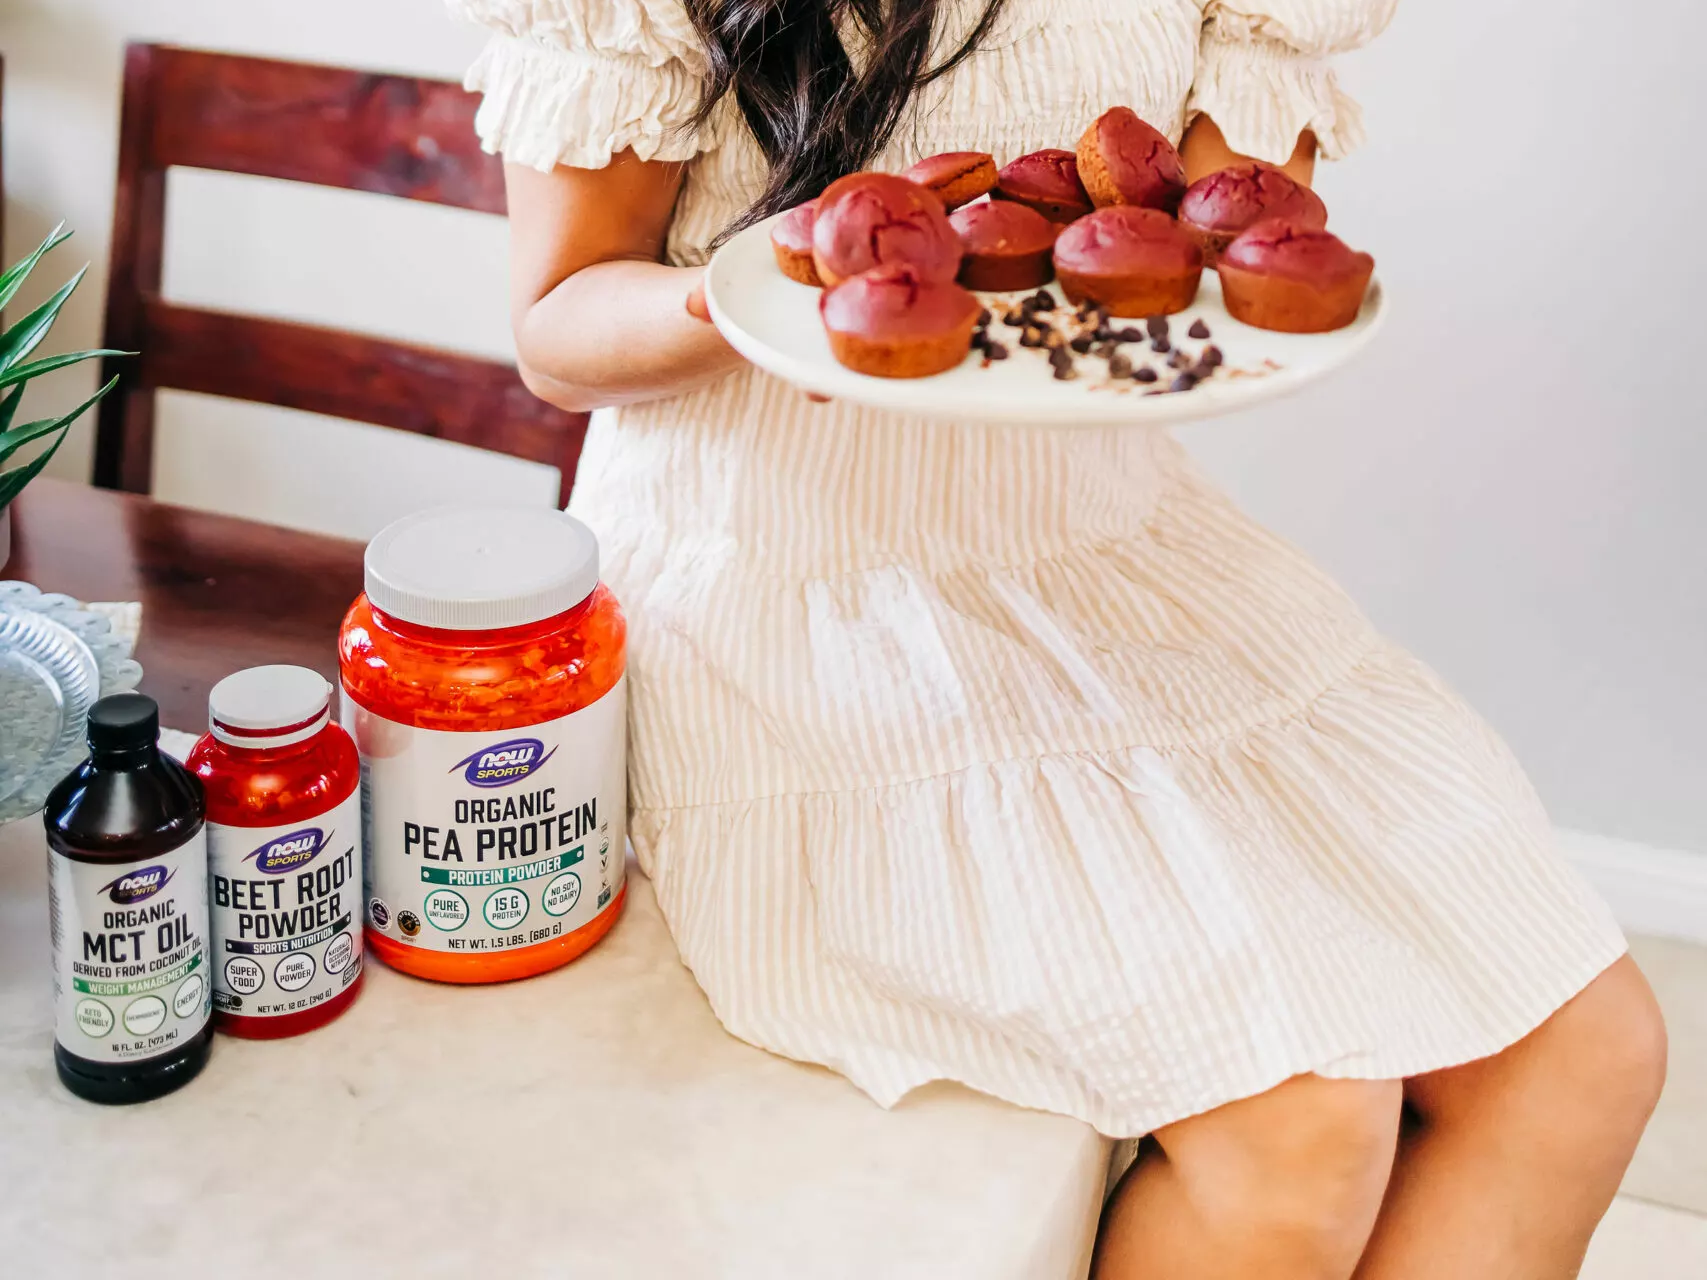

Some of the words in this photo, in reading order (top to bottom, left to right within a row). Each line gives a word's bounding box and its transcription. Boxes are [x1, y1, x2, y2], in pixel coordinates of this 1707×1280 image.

[476, 765, 529, 779] SPORTS
[455, 787, 555, 823] ORGANIC
[404, 821, 463, 862] PEA
[477, 797, 597, 862] PROTEIN
[266, 851, 312, 867] SPORTS
[449, 870, 504, 885] PROTEIN
[508, 856, 561, 881] POWDER
[214, 875, 285, 911] BEET
[297, 846, 354, 905] ROOT
[551, 886, 561, 896] NO
[562, 880, 576, 892] SOY
[433, 899, 460, 911] PURE
[494, 896, 507, 911] 15
[511, 895, 519, 909] G
[547, 897, 558, 907] NO
[559, 889, 578, 904] DAIRY
[104, 898, 175, 929] ORGANIC
[239, 892, 341, 939] POWDER
[429, 910, 464, 920] UNFLAVORED
[492, 910, 521, 920] PROTEIN
[83, 930, 146, 963] MCT
[157, 912, 193, 954] OIL
[253, 942, 289, 954] SPORTS
[290, 927, 334, 950] NUTRITION
[448, 939, 466, 949] NET
[470, 939, 488, 949] WT.
[491, 937, 503, 948] 1.5
[507, 934, 526, 946] LBS.
[73, 961, 112, 978] DERIVED
[116, 964, 146, 977] FROM
[150, 946, 189, 972] COCONUT
[192, 935, 202, 951] OIL
[230, 965, 257, 977] SUPER
[286, 962, 305, 973] PURE
[233, 978, 255, 988] FOOD
[280, 969, 311, 983] POWDER
[88, 982, 125, 995] WEIGHT
[84, 1008, 102, 1017] KETO
[258, 1005, 270, 1014] NET
[273, 1003, 287, 1013] WT.
[288, 1002, 296, 1010] 12
[297, 999, 308, 1009] OZ.
[79, 1015, 109, 1028] FRIENDLY
